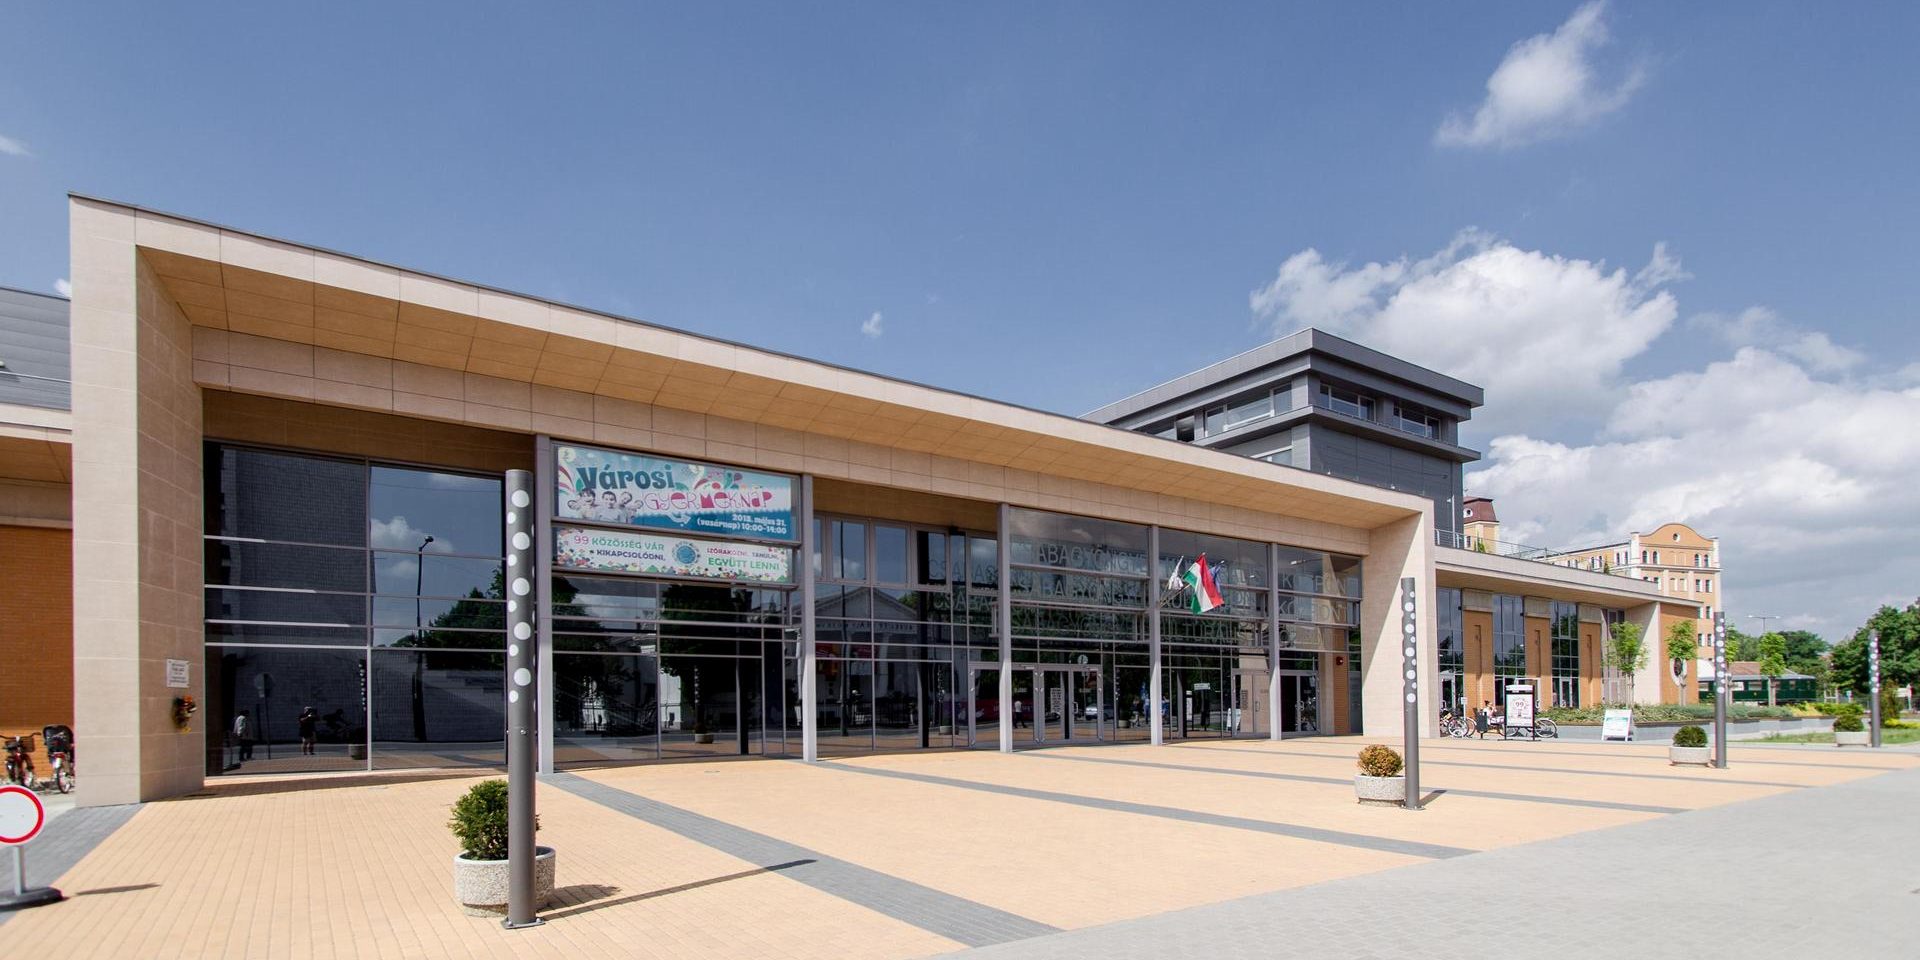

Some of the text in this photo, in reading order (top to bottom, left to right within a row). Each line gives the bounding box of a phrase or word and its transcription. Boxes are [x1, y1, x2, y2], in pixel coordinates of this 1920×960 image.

[576, 464, 675, 490] Városi
[575, 535, 665, 551] 99 KÖZÖSSÉG VÁR
[708, 557, 780, 571] EGYÜTT LENNI
